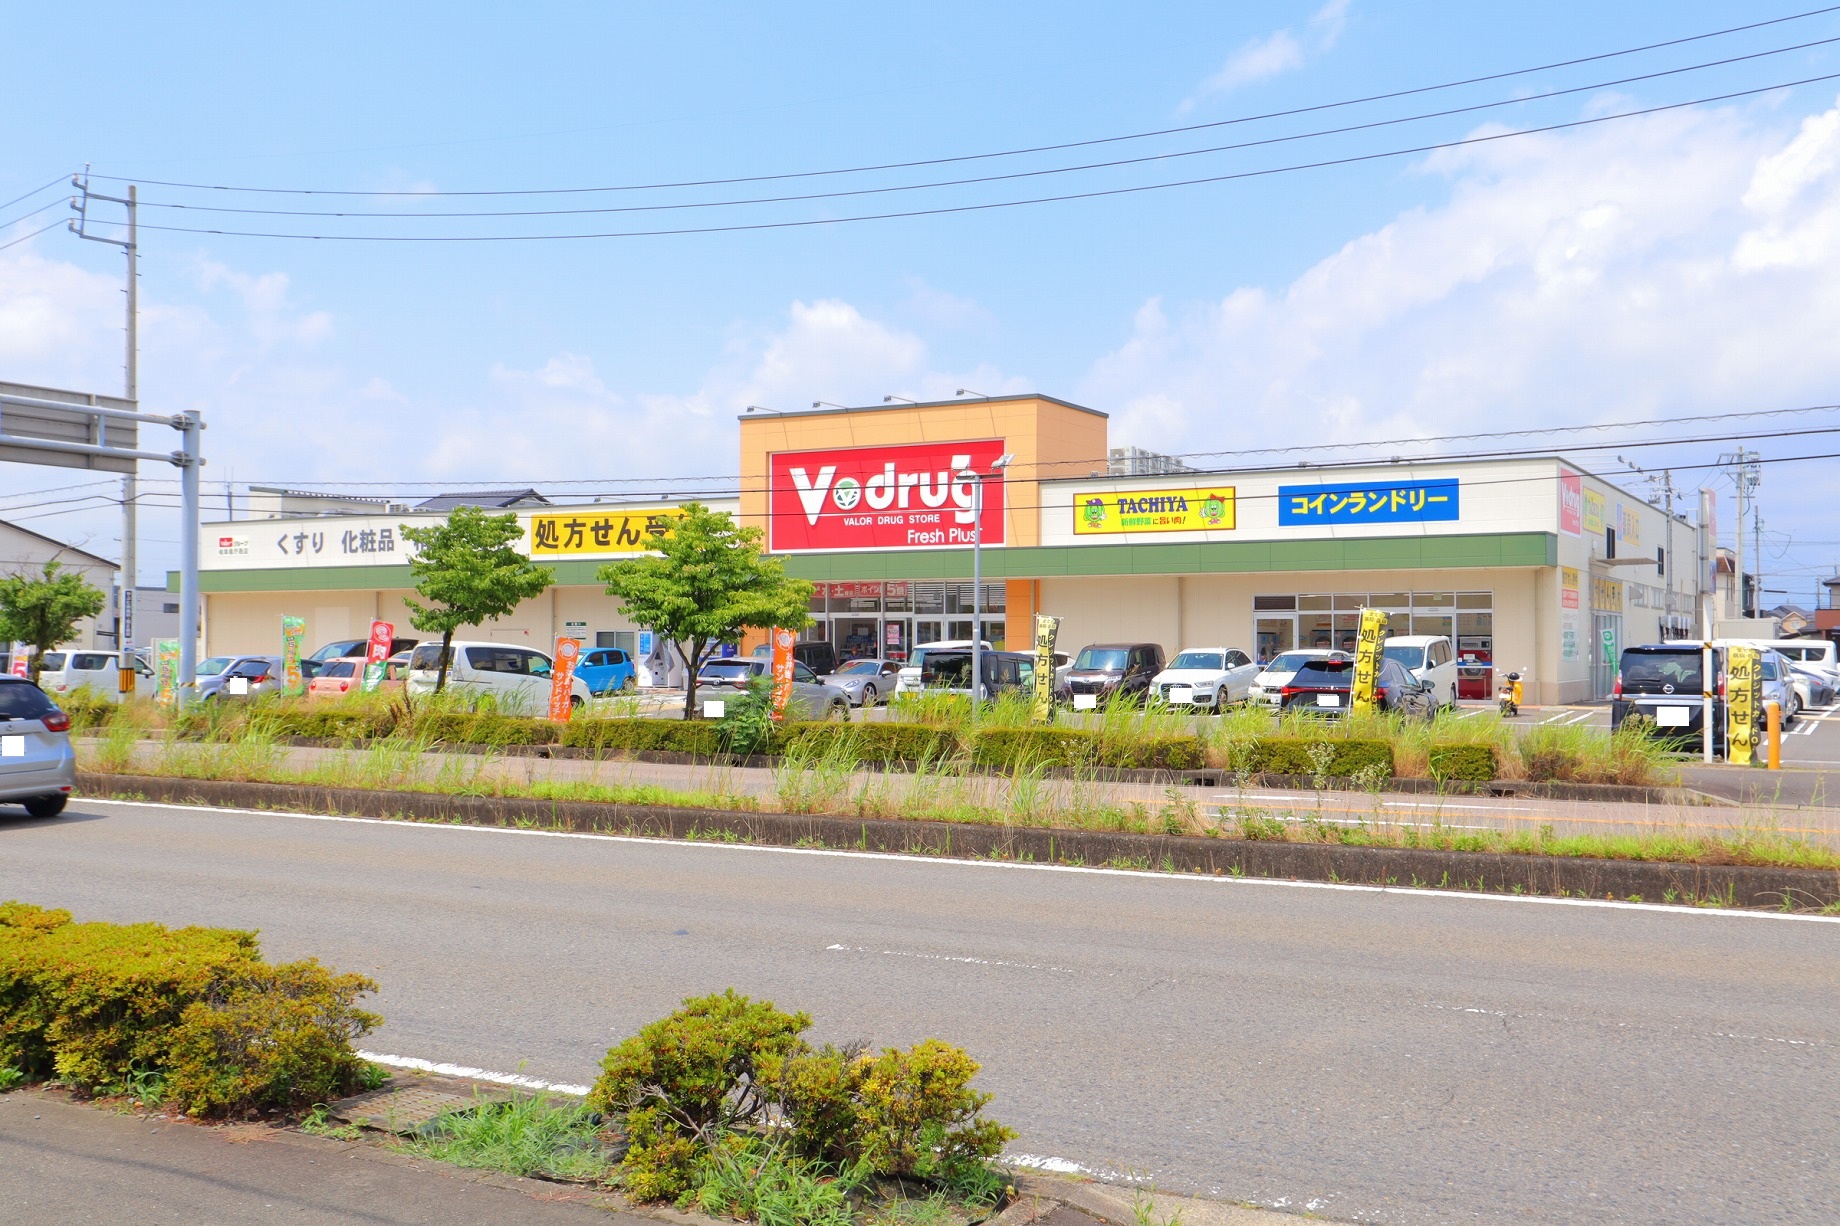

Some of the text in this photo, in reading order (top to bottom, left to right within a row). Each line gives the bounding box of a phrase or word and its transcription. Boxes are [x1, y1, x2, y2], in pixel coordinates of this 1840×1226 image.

[1117, 496, 1188, 514] TACHIYA
[1291, 489, 1448, 515] コインランドリー
[535, 511, 684, 549] 処方せん受
[844, 513, 940, 526] VALOR DRUG STORE
[277, 532, 324, 554] くすり
[342, 528, 395, 553] 化粧品
[907, 526, 978, 544] Fresh Plus
[1356, 630, 1376, 703] 処方せん
[1730, 665, 1750, 747] 処方せん
[1751, 664, 1762, 752] クレジットカードO
